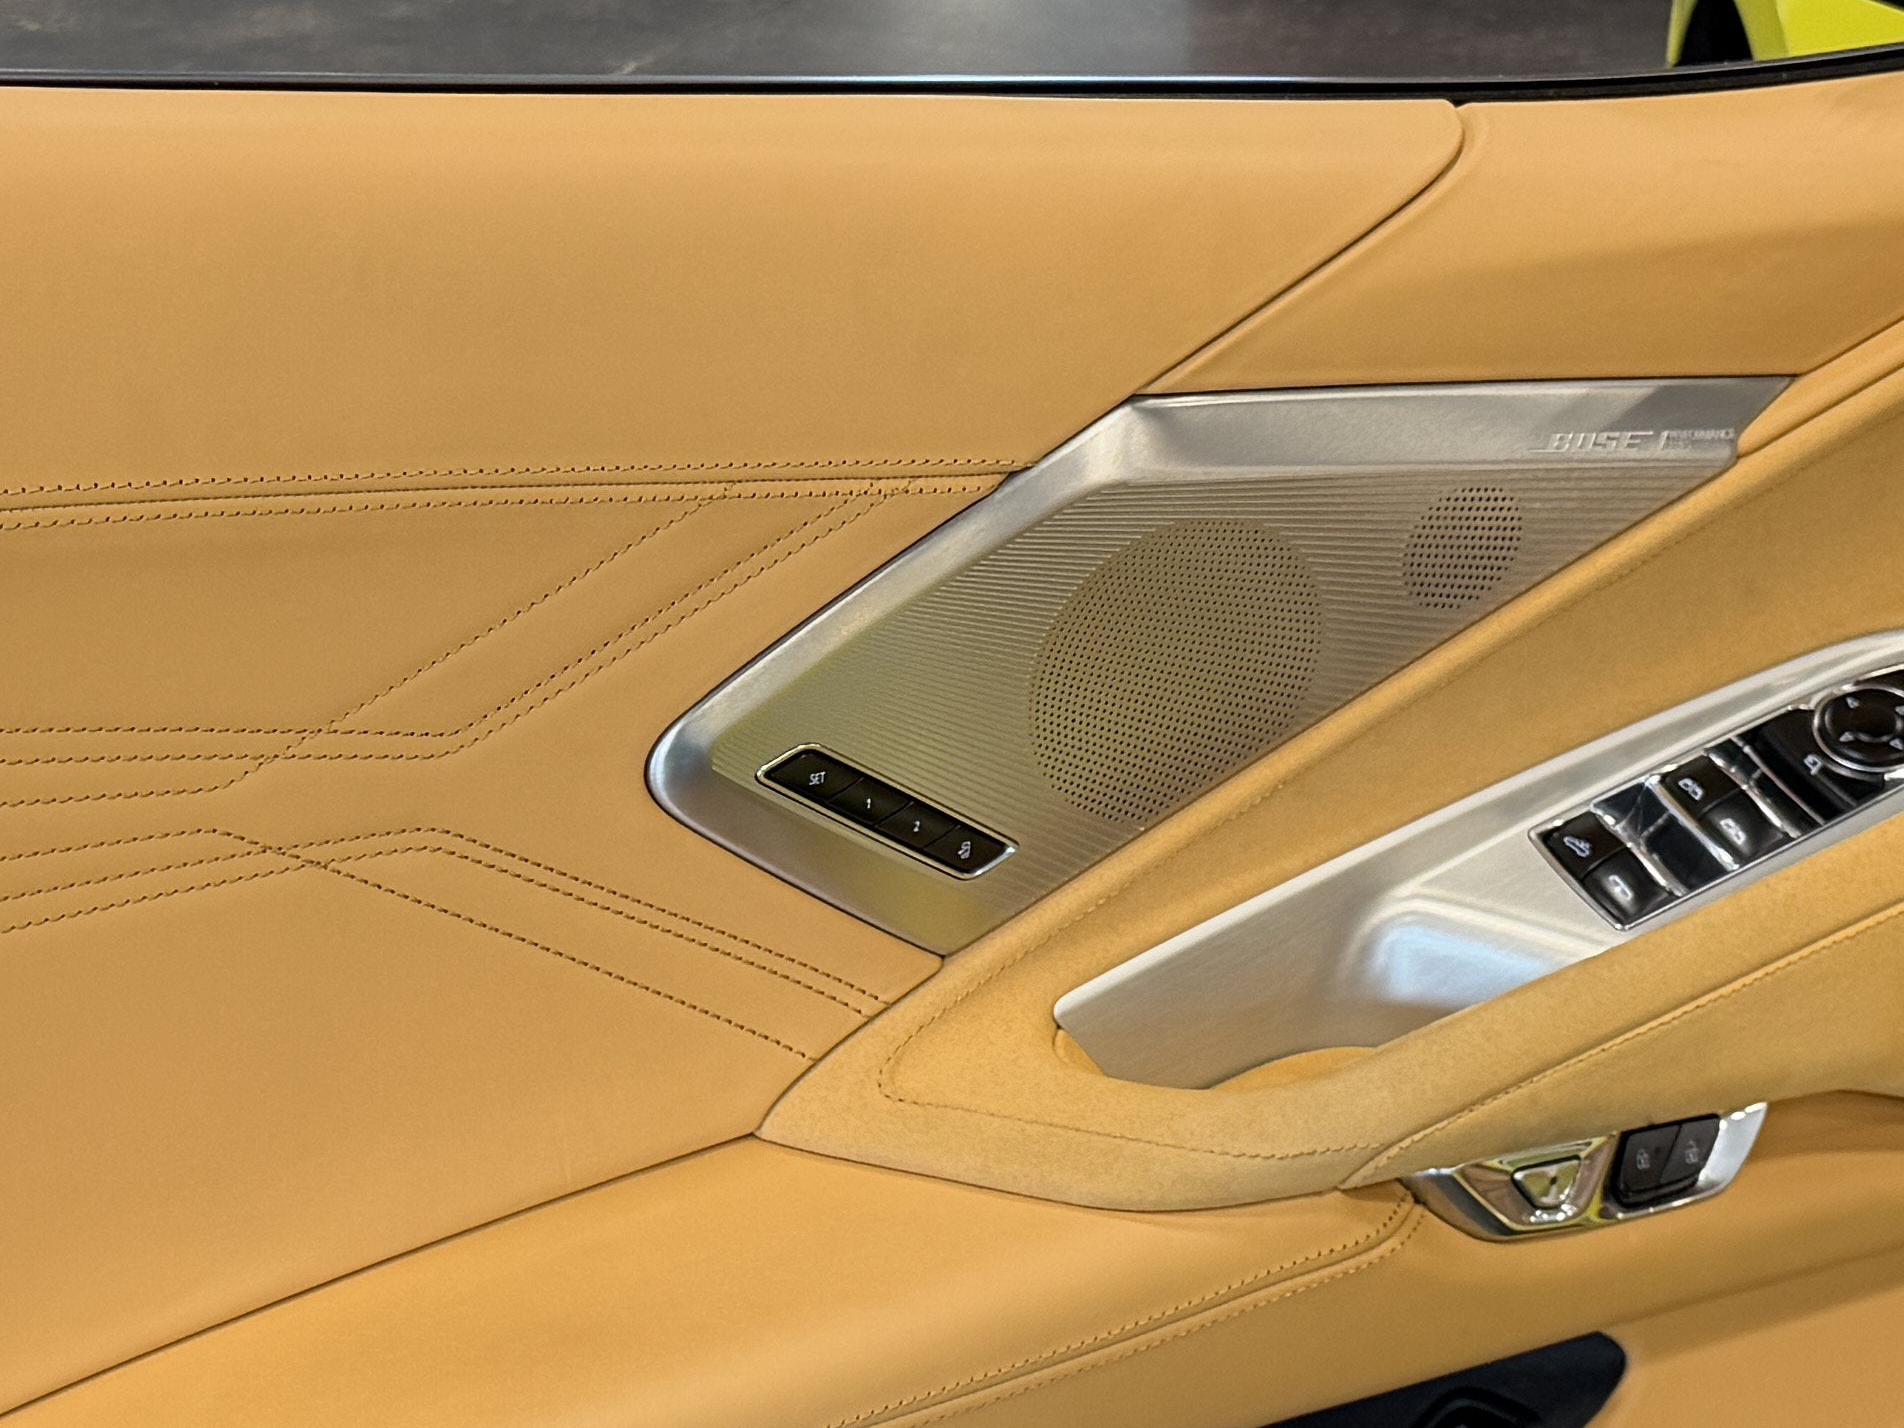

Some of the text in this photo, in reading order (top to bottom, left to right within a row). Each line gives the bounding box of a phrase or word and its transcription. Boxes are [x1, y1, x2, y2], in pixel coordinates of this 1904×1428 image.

[1528, 431, 1655, 453] BOSE
[808, 771, 826, 786] SET
[866, 797, 873, 810] 1
[912, 820, 922, 833] 2
